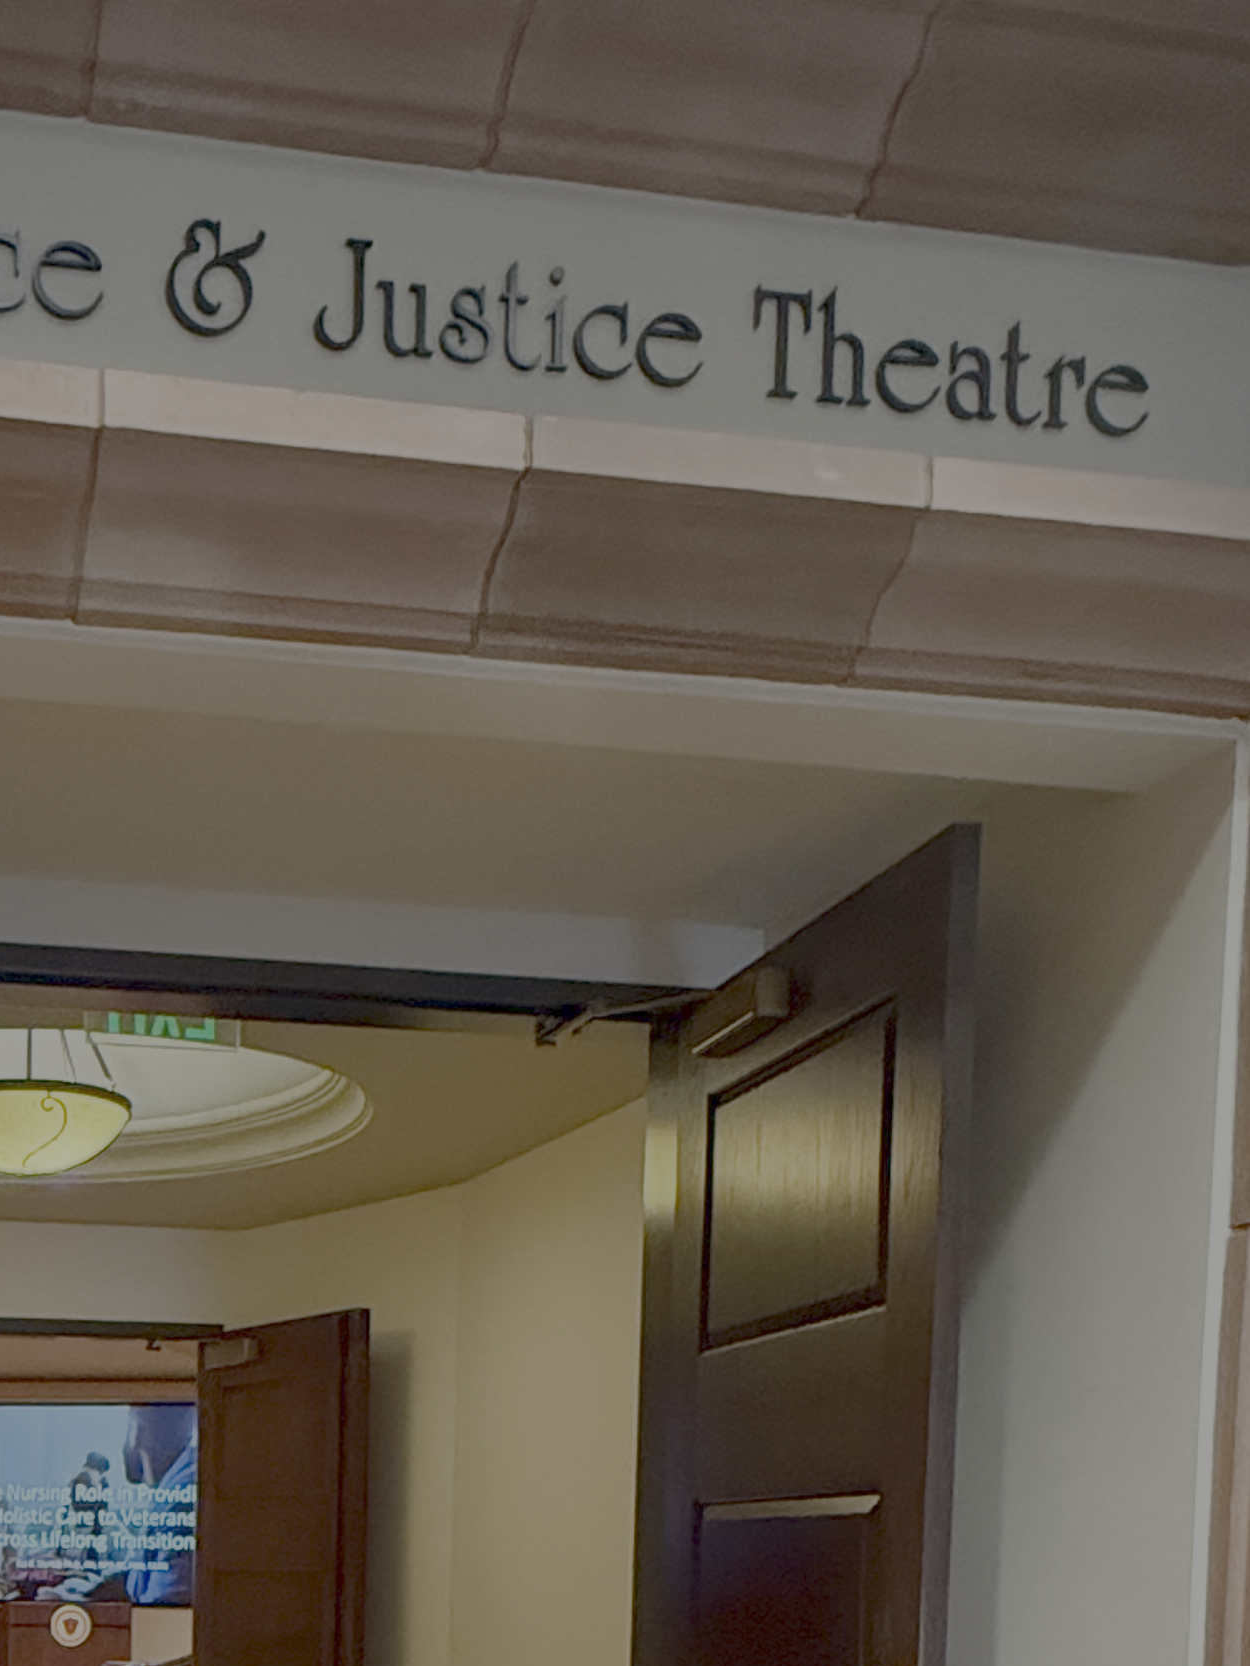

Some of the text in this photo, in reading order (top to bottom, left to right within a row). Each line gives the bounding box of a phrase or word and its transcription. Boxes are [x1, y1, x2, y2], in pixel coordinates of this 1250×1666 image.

[165, 218, 266, 337] &
[312, 238, 704, 390] Justice
[752, 285, 1151, 438] Theatre
[7, 1483, 71, 1505] Nursing
[75, 1484, 113, 1503] Role
[117, 1484, 134, 1502] in
[55, 1507, 95, 1527] Care
[98, 1509, 118, 1526] to
[120, 1508, 197, 1528] Veterans
[41, 1530, 107, 1553] Lifelong
[110, 1530, 197, 1551] Transition
